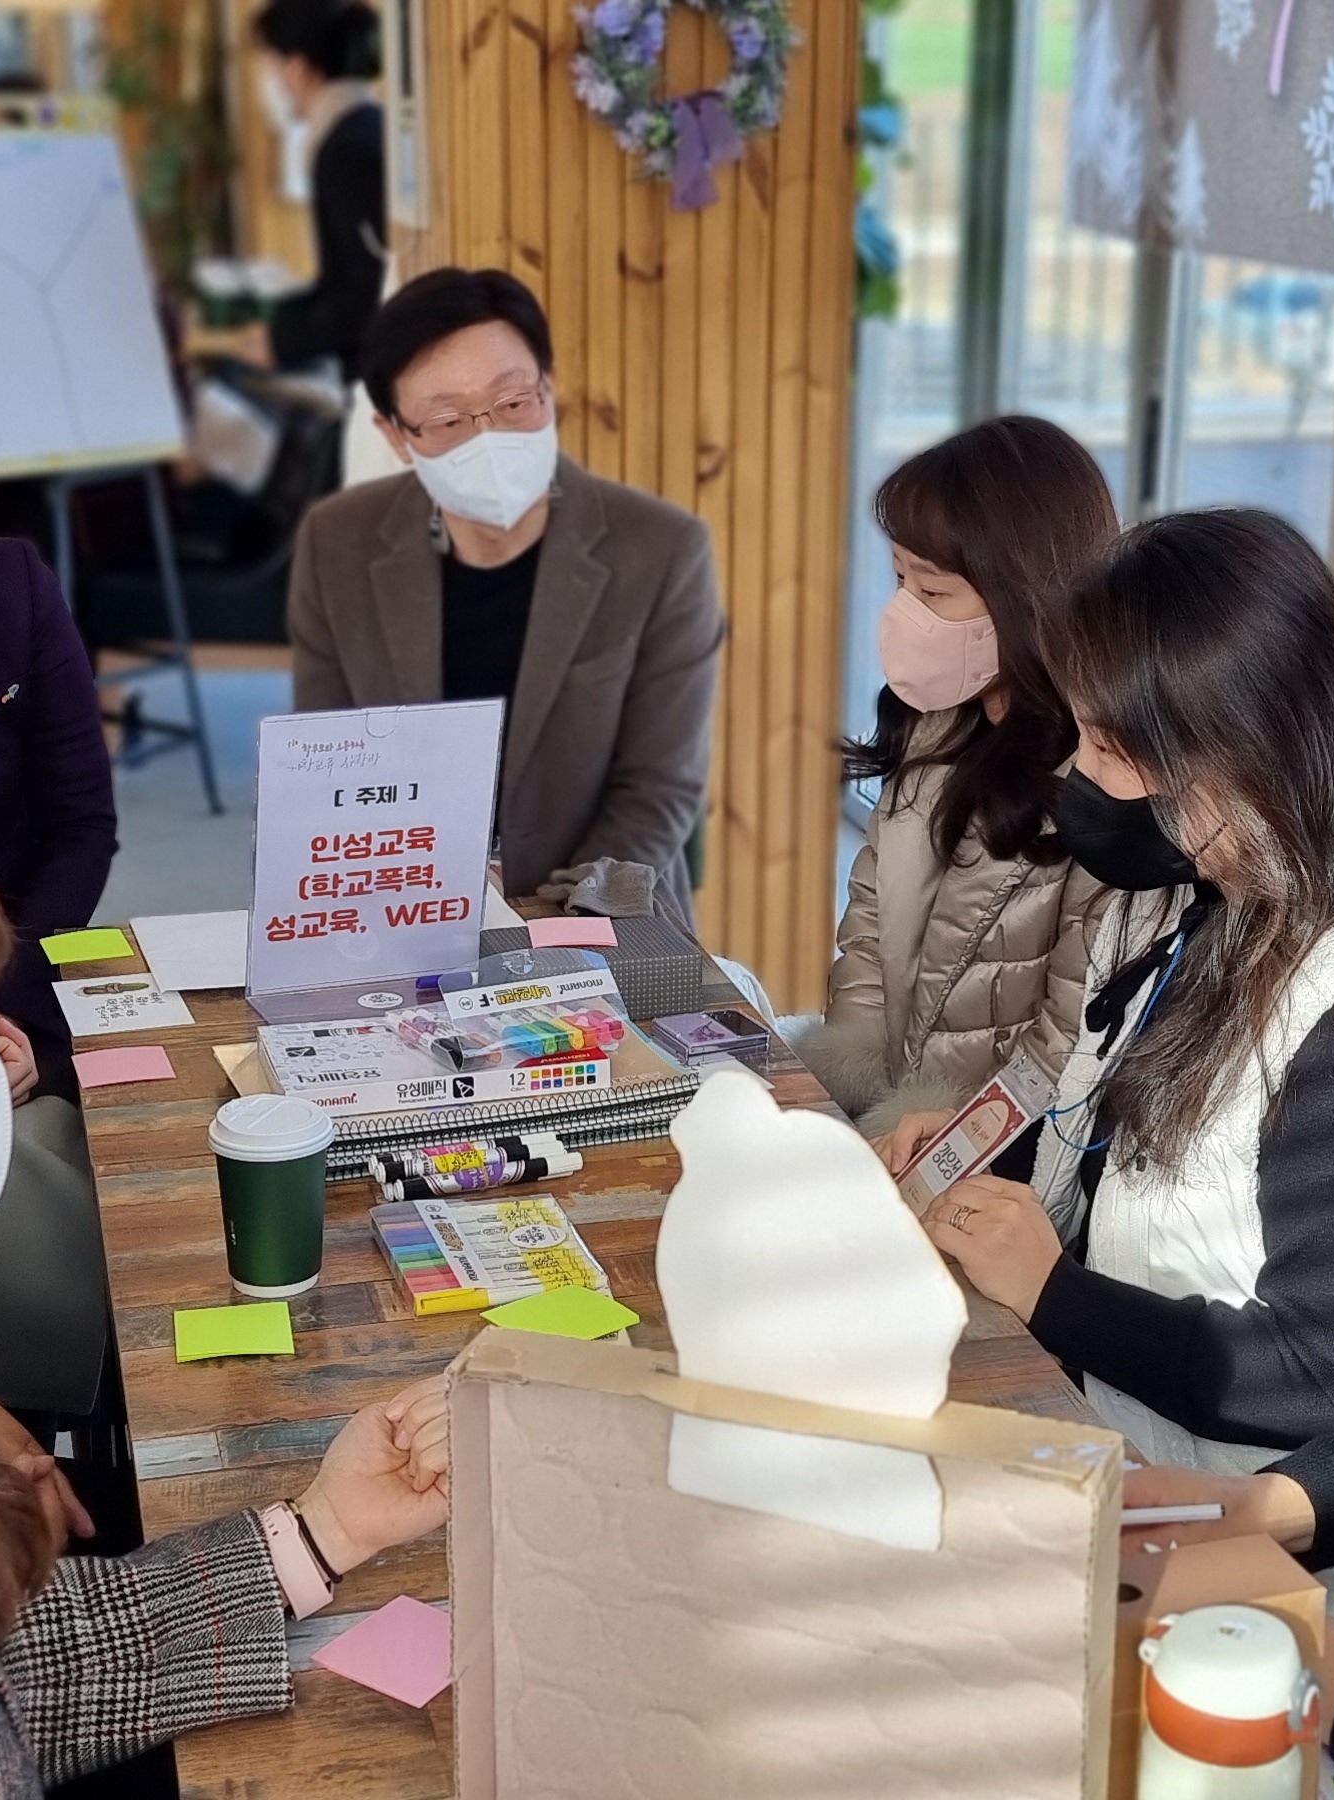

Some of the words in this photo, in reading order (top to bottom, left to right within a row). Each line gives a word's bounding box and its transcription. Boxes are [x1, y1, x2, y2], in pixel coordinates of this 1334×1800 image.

[355, 785, 397, 805] 주제
[310, 826, 436, 863] 인성교육
[298, 864, 442, 901] (학교폭력,
[265, 908, 367, 942] 성교육,
[385, 897, 471, 928] WEE)
[397, 1079, 446, 1098] 유성매직
[509, 1072, 526, 1086] 12
